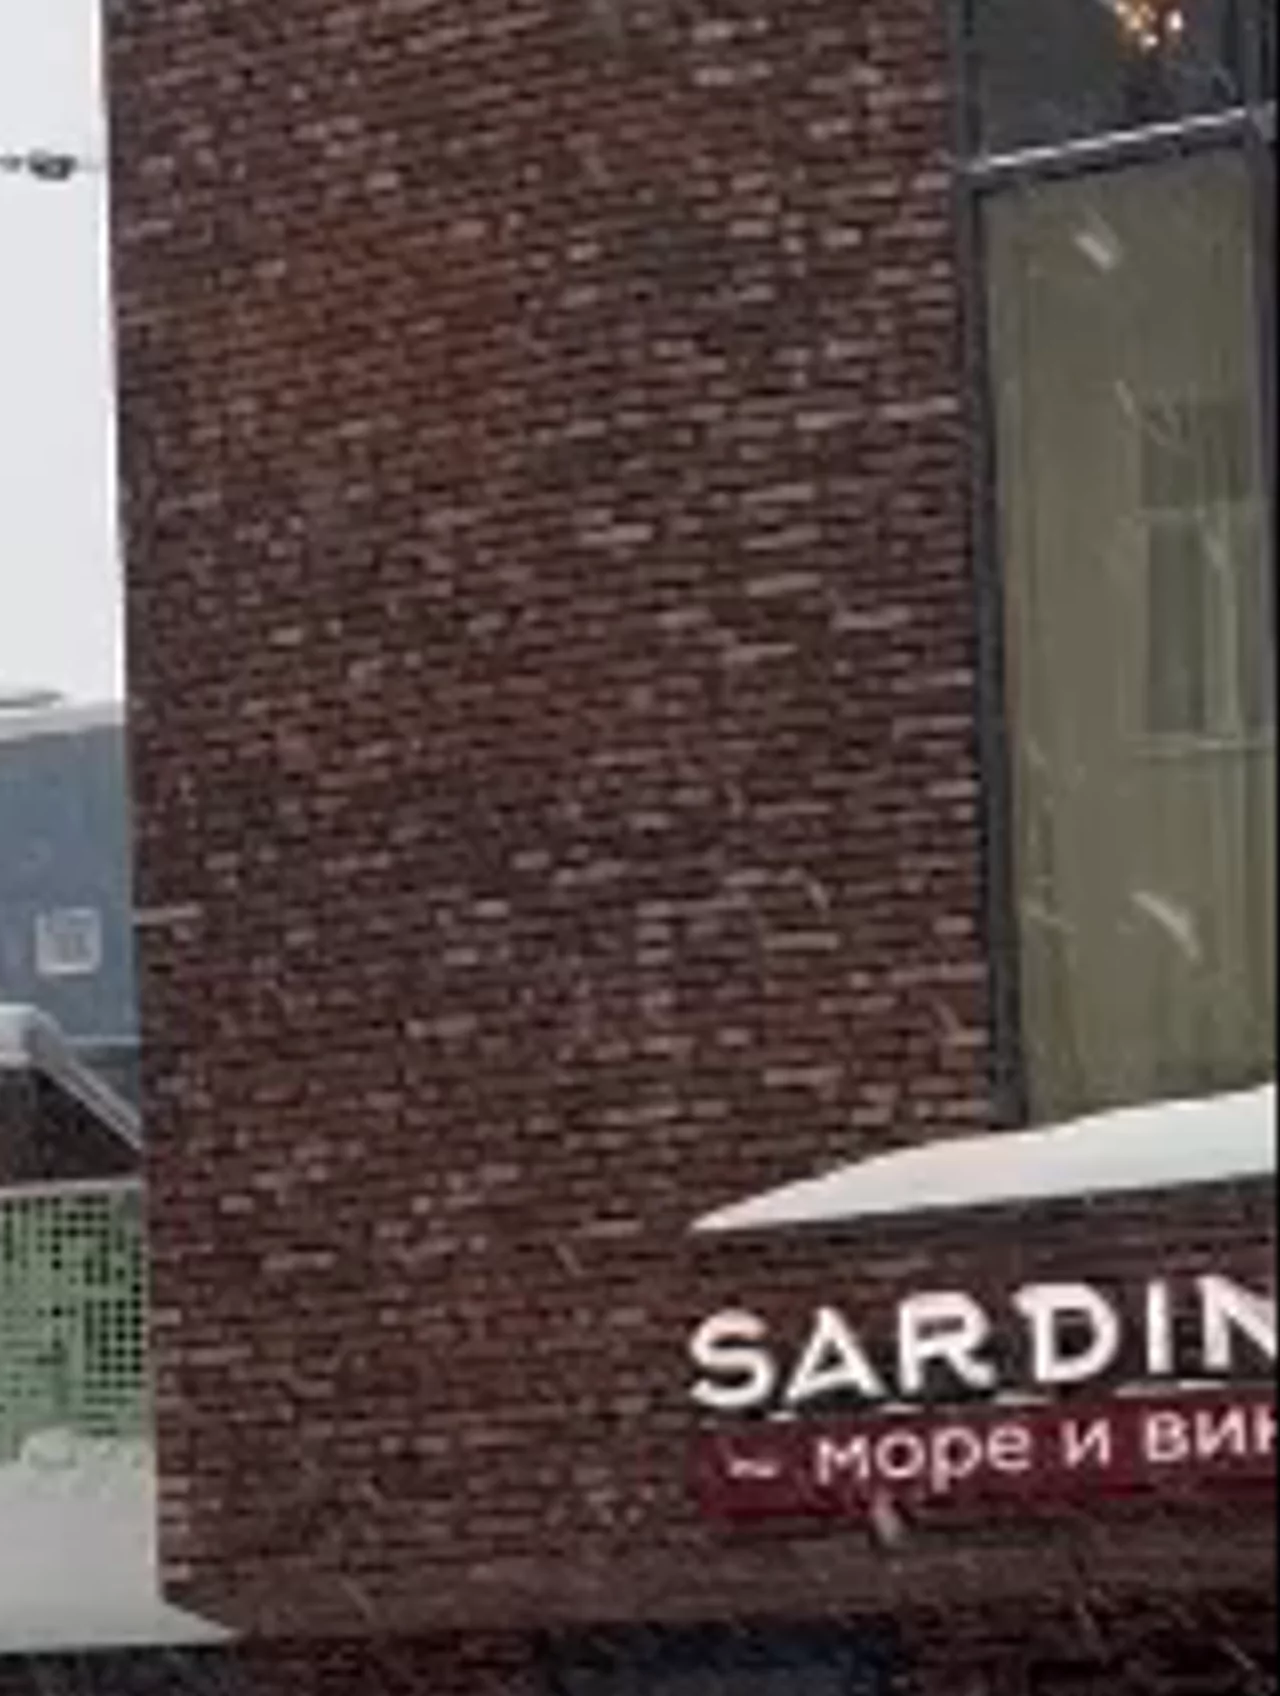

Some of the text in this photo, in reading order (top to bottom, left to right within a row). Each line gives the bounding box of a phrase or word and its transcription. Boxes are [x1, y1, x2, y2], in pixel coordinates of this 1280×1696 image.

[689, 1273, 1278, 1407] SARDIN
[815, 1424, 1033, 1492] море
[1062, 1417, 1112, 1469] и
